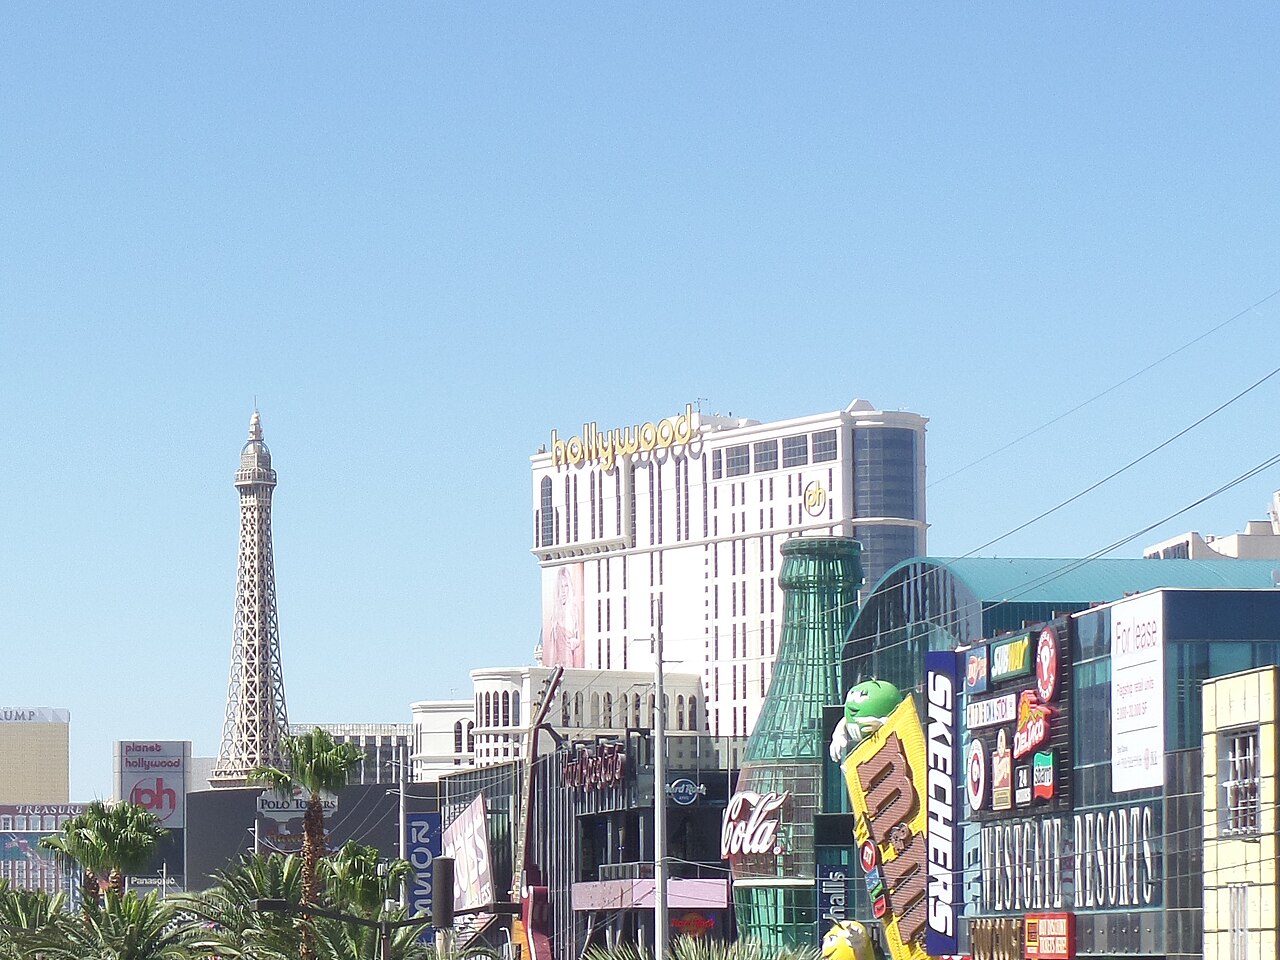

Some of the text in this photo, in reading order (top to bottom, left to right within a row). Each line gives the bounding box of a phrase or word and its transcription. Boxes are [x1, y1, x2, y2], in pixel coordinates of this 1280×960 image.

[551, 403, 692, 471] hollywood
[1132, 617, 1157, 650] lease
[991, 639, 1029, 678] SUBWAY
[125, 743, 162, 753] planet
[125, 758, 181, 770] hollywood
[134, 777, 177, 810] ph
[685, 783, 707, 796] Rock
[16, 804, 83, 815] TREASURE
[261, 799, 336, 809] POLO TORS
[927, 670, 953, 938] SKECHERS
[980, 806, 1152, 911] WESTGATE RESORTS
[130, 877, 176, 885] Panasonic
